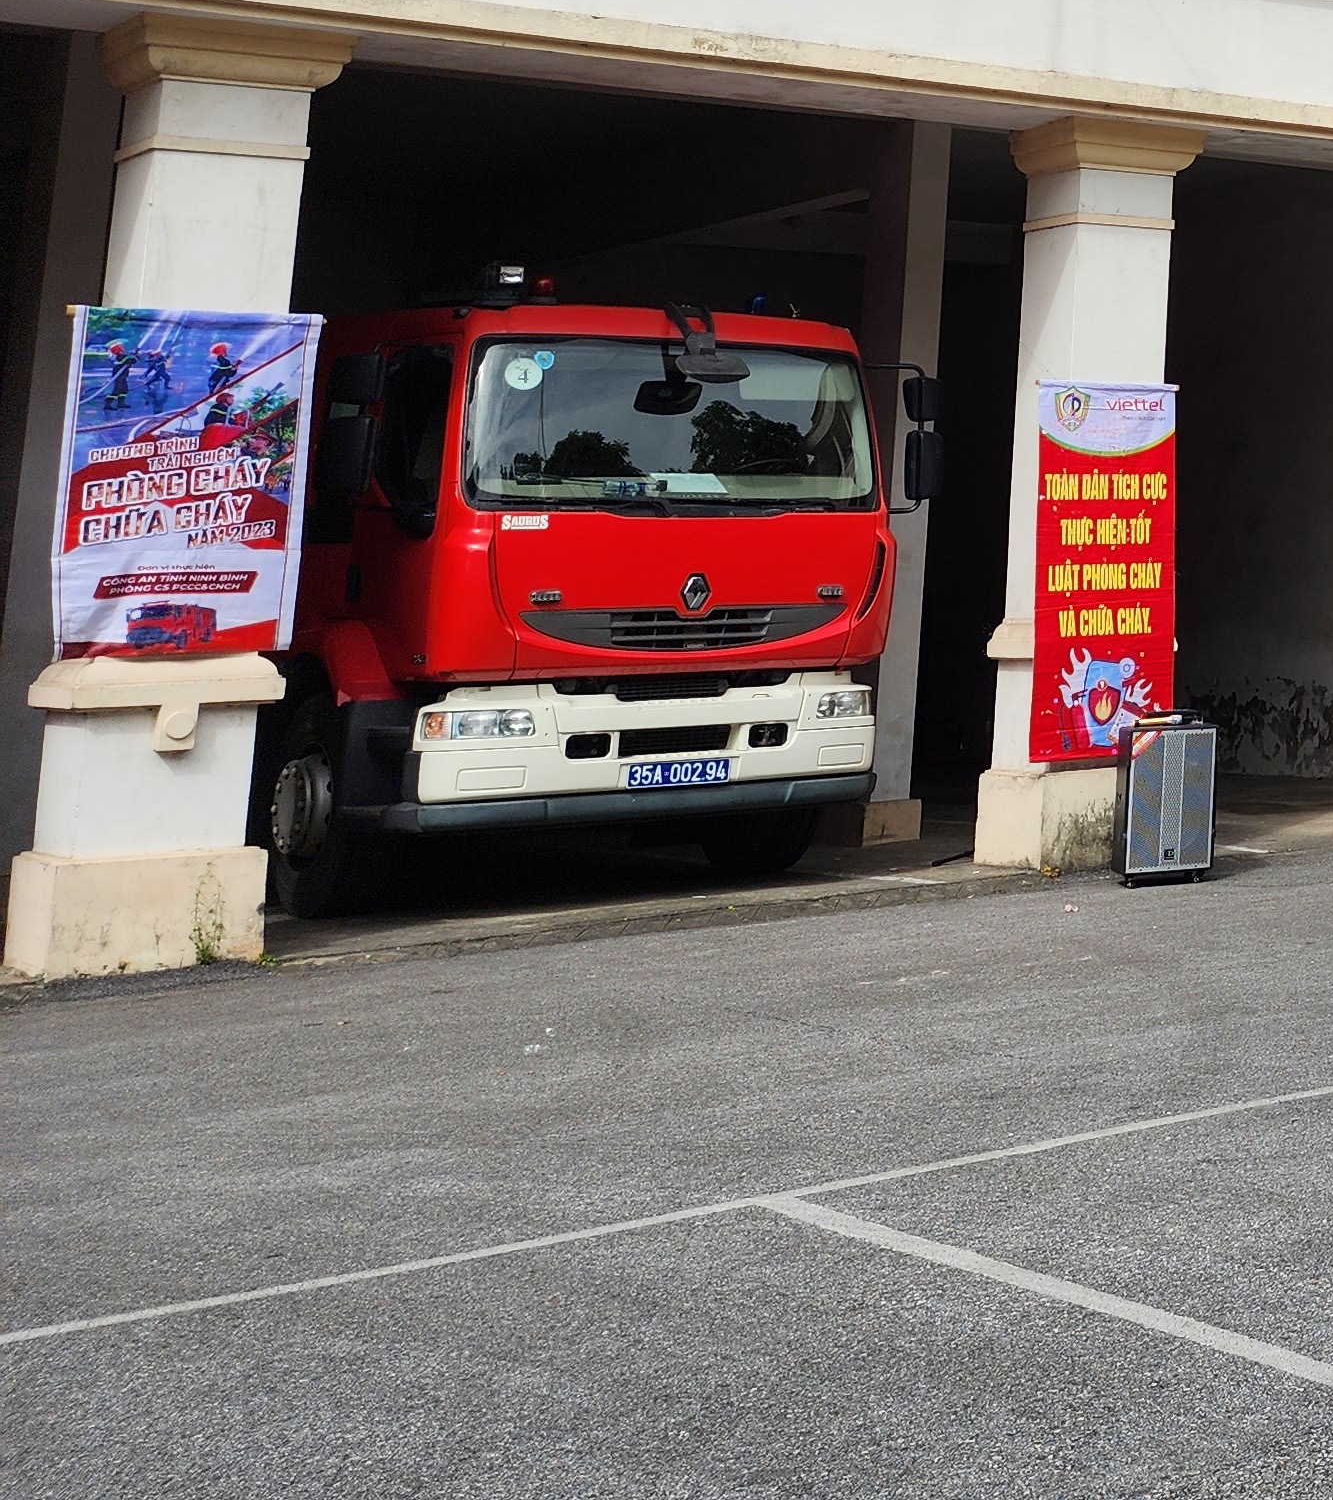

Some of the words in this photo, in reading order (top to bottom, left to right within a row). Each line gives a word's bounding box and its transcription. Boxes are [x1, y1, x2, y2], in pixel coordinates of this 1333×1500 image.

[517, 368, 530, 384] 4
[1106, 398, 1165, 412] viettel
[148, 454, 180, 471] TRẢI
[182, 447, 237, 467] NGHIỆM
[157, 437, 199, 454] TRÌNH
[83, 469, 186, 510] PHÒNG
[190, 457, 270, 495] CHÁY
[1045, 468, 1079, 500] TOÀN
[1082, 468, 1108, 500] DÂN
[1112, 469, 1139, 500] TÍCH
[1142, 471, 1167, 505] CỰC
[80, 504, 168, 545] CHỮA
[174, 494, 252, 533] CHÁY
[1060, 516, 1093, 551] THỰC
[1096, 513, 1126, 550] HIỆN
[1129, 509, 1151, 544] TỐT
[187, 525, 228, 549] NĂM
[228, 520, 275, 542] 2023
[102, 574, 136, 586] CÔNG
[138, 575, 157, 584] AN
[189, 574, 216, 582] NINH
[154, 583, 170, 592] CS
[1048, 559, 1080, 597] LUẬT
[1083, 557, 1126, 590] PHÒNG
[1130, 557, 1162, 589] CHÁY
[1059, 605, 1076, 637] VÀ
[1080, 604, 1114, 636] CHỮA
[1117, 602, 1151, 634] CHÁY.
